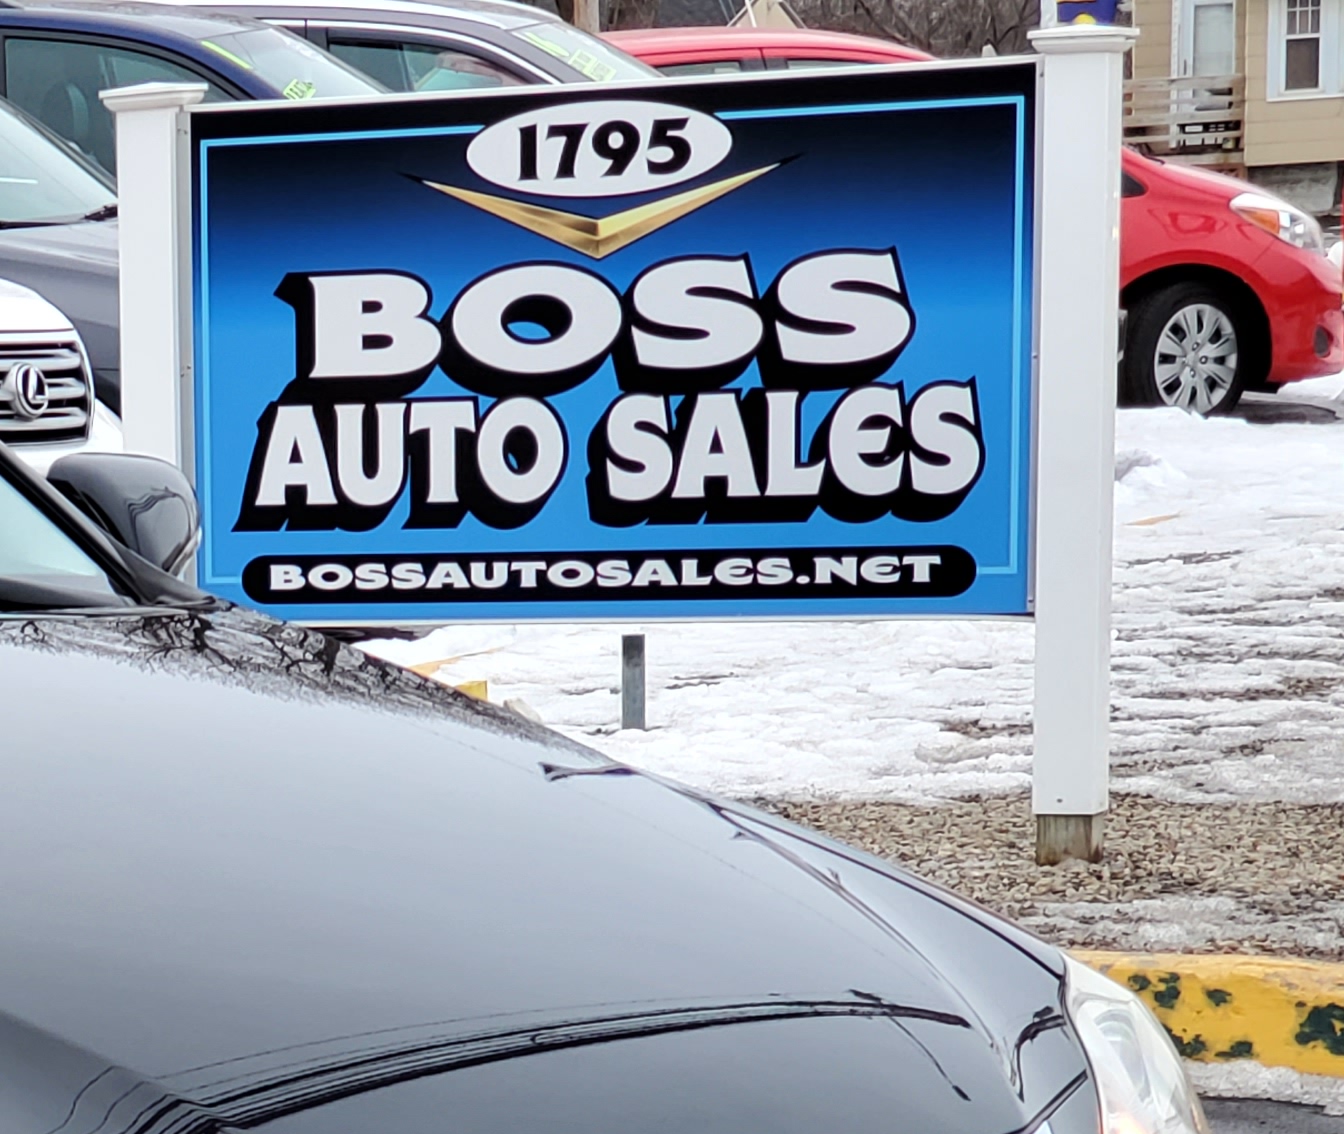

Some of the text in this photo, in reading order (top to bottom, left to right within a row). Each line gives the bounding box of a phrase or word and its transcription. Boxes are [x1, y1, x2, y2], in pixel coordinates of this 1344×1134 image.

[518, 116, 692, 181] 1795
[275, 245, 916, 400] BOSS
[247, 378, 984, 510] AUTO SALES
[269, 555, 941, 591] BOSSAUTOSALES.NET
